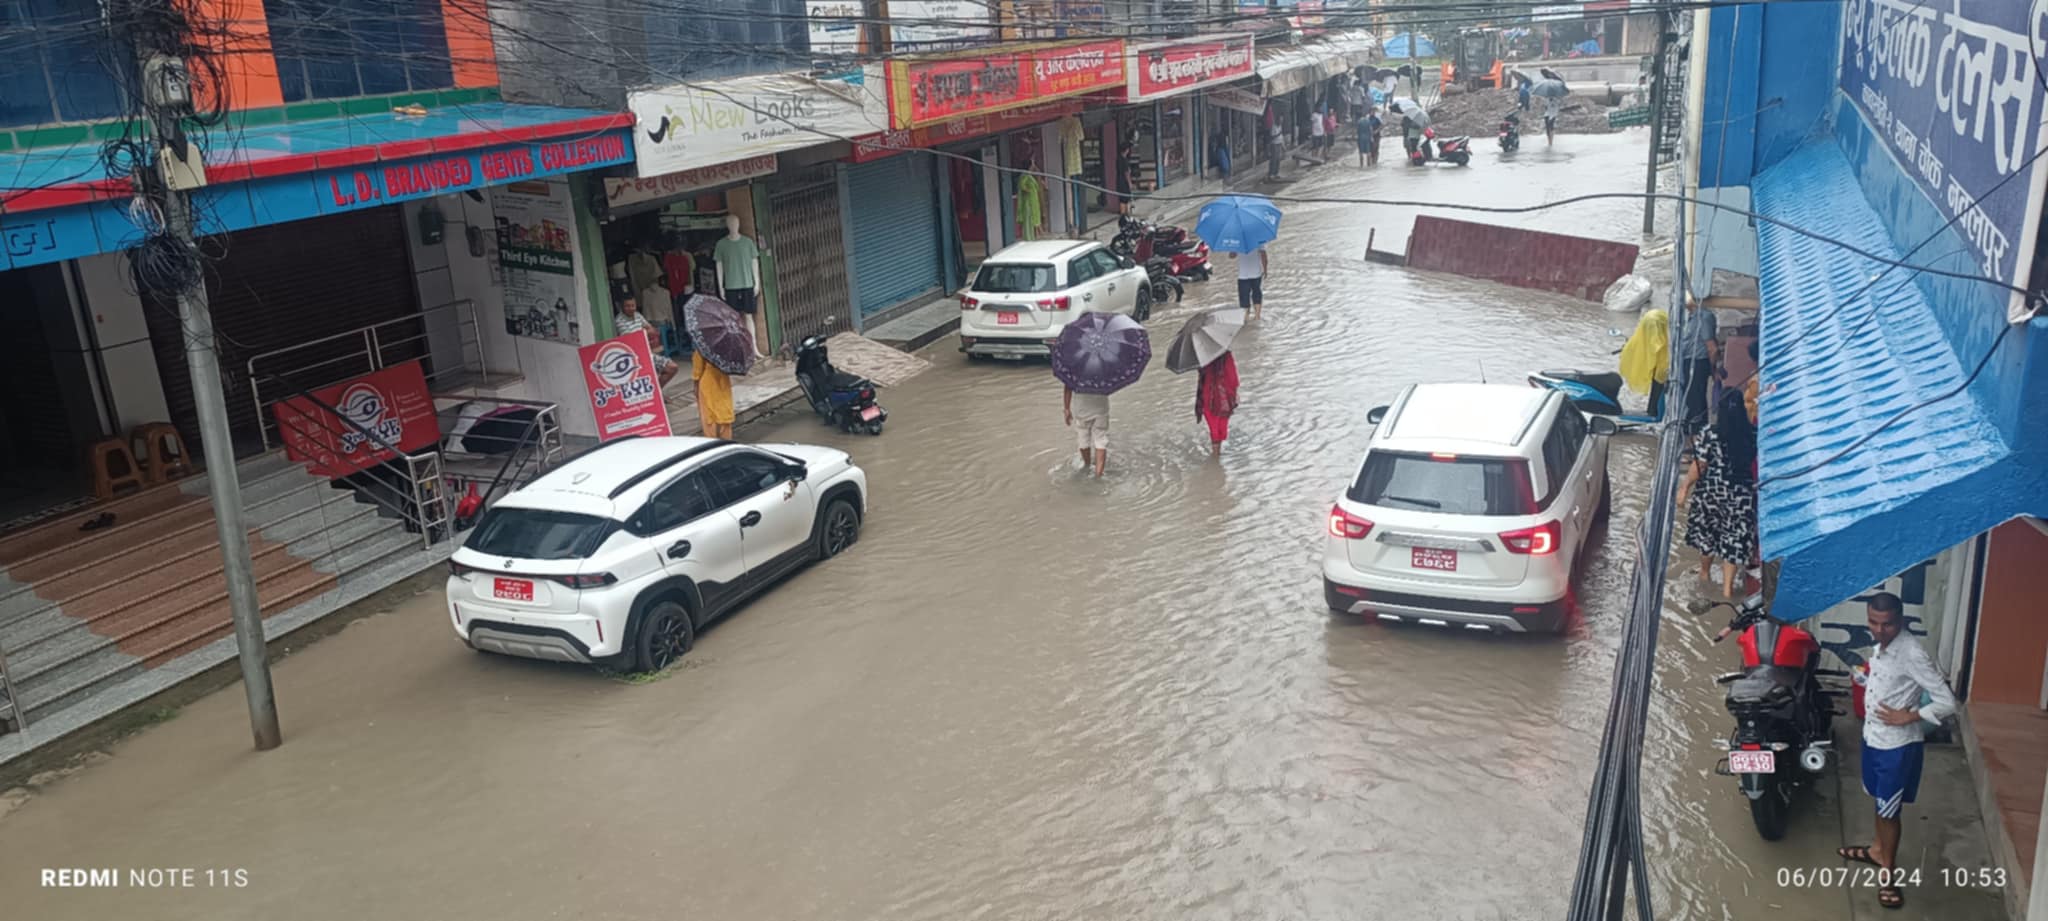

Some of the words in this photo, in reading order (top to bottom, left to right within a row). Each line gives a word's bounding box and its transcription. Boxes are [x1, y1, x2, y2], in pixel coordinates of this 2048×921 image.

[690, 101, 745, 134] New
[753, 94, 815, 125] Looks
[741, 131, 757, 142] The
[384, 157, 472, 198] BRANDED
[480, 146, 533, 181] GENTS
[540, 134, 626, 171] COLLECTION
[1948, 173, 2009, 281] नवलपुर
[502, 251, 522, 262] Third
[523, 252, 538, 266] Eye
[539, 254, 570, 268] Kitchen
[594, 387, 617, 407] 3rd
[620, 377, 654, 399] EYE
